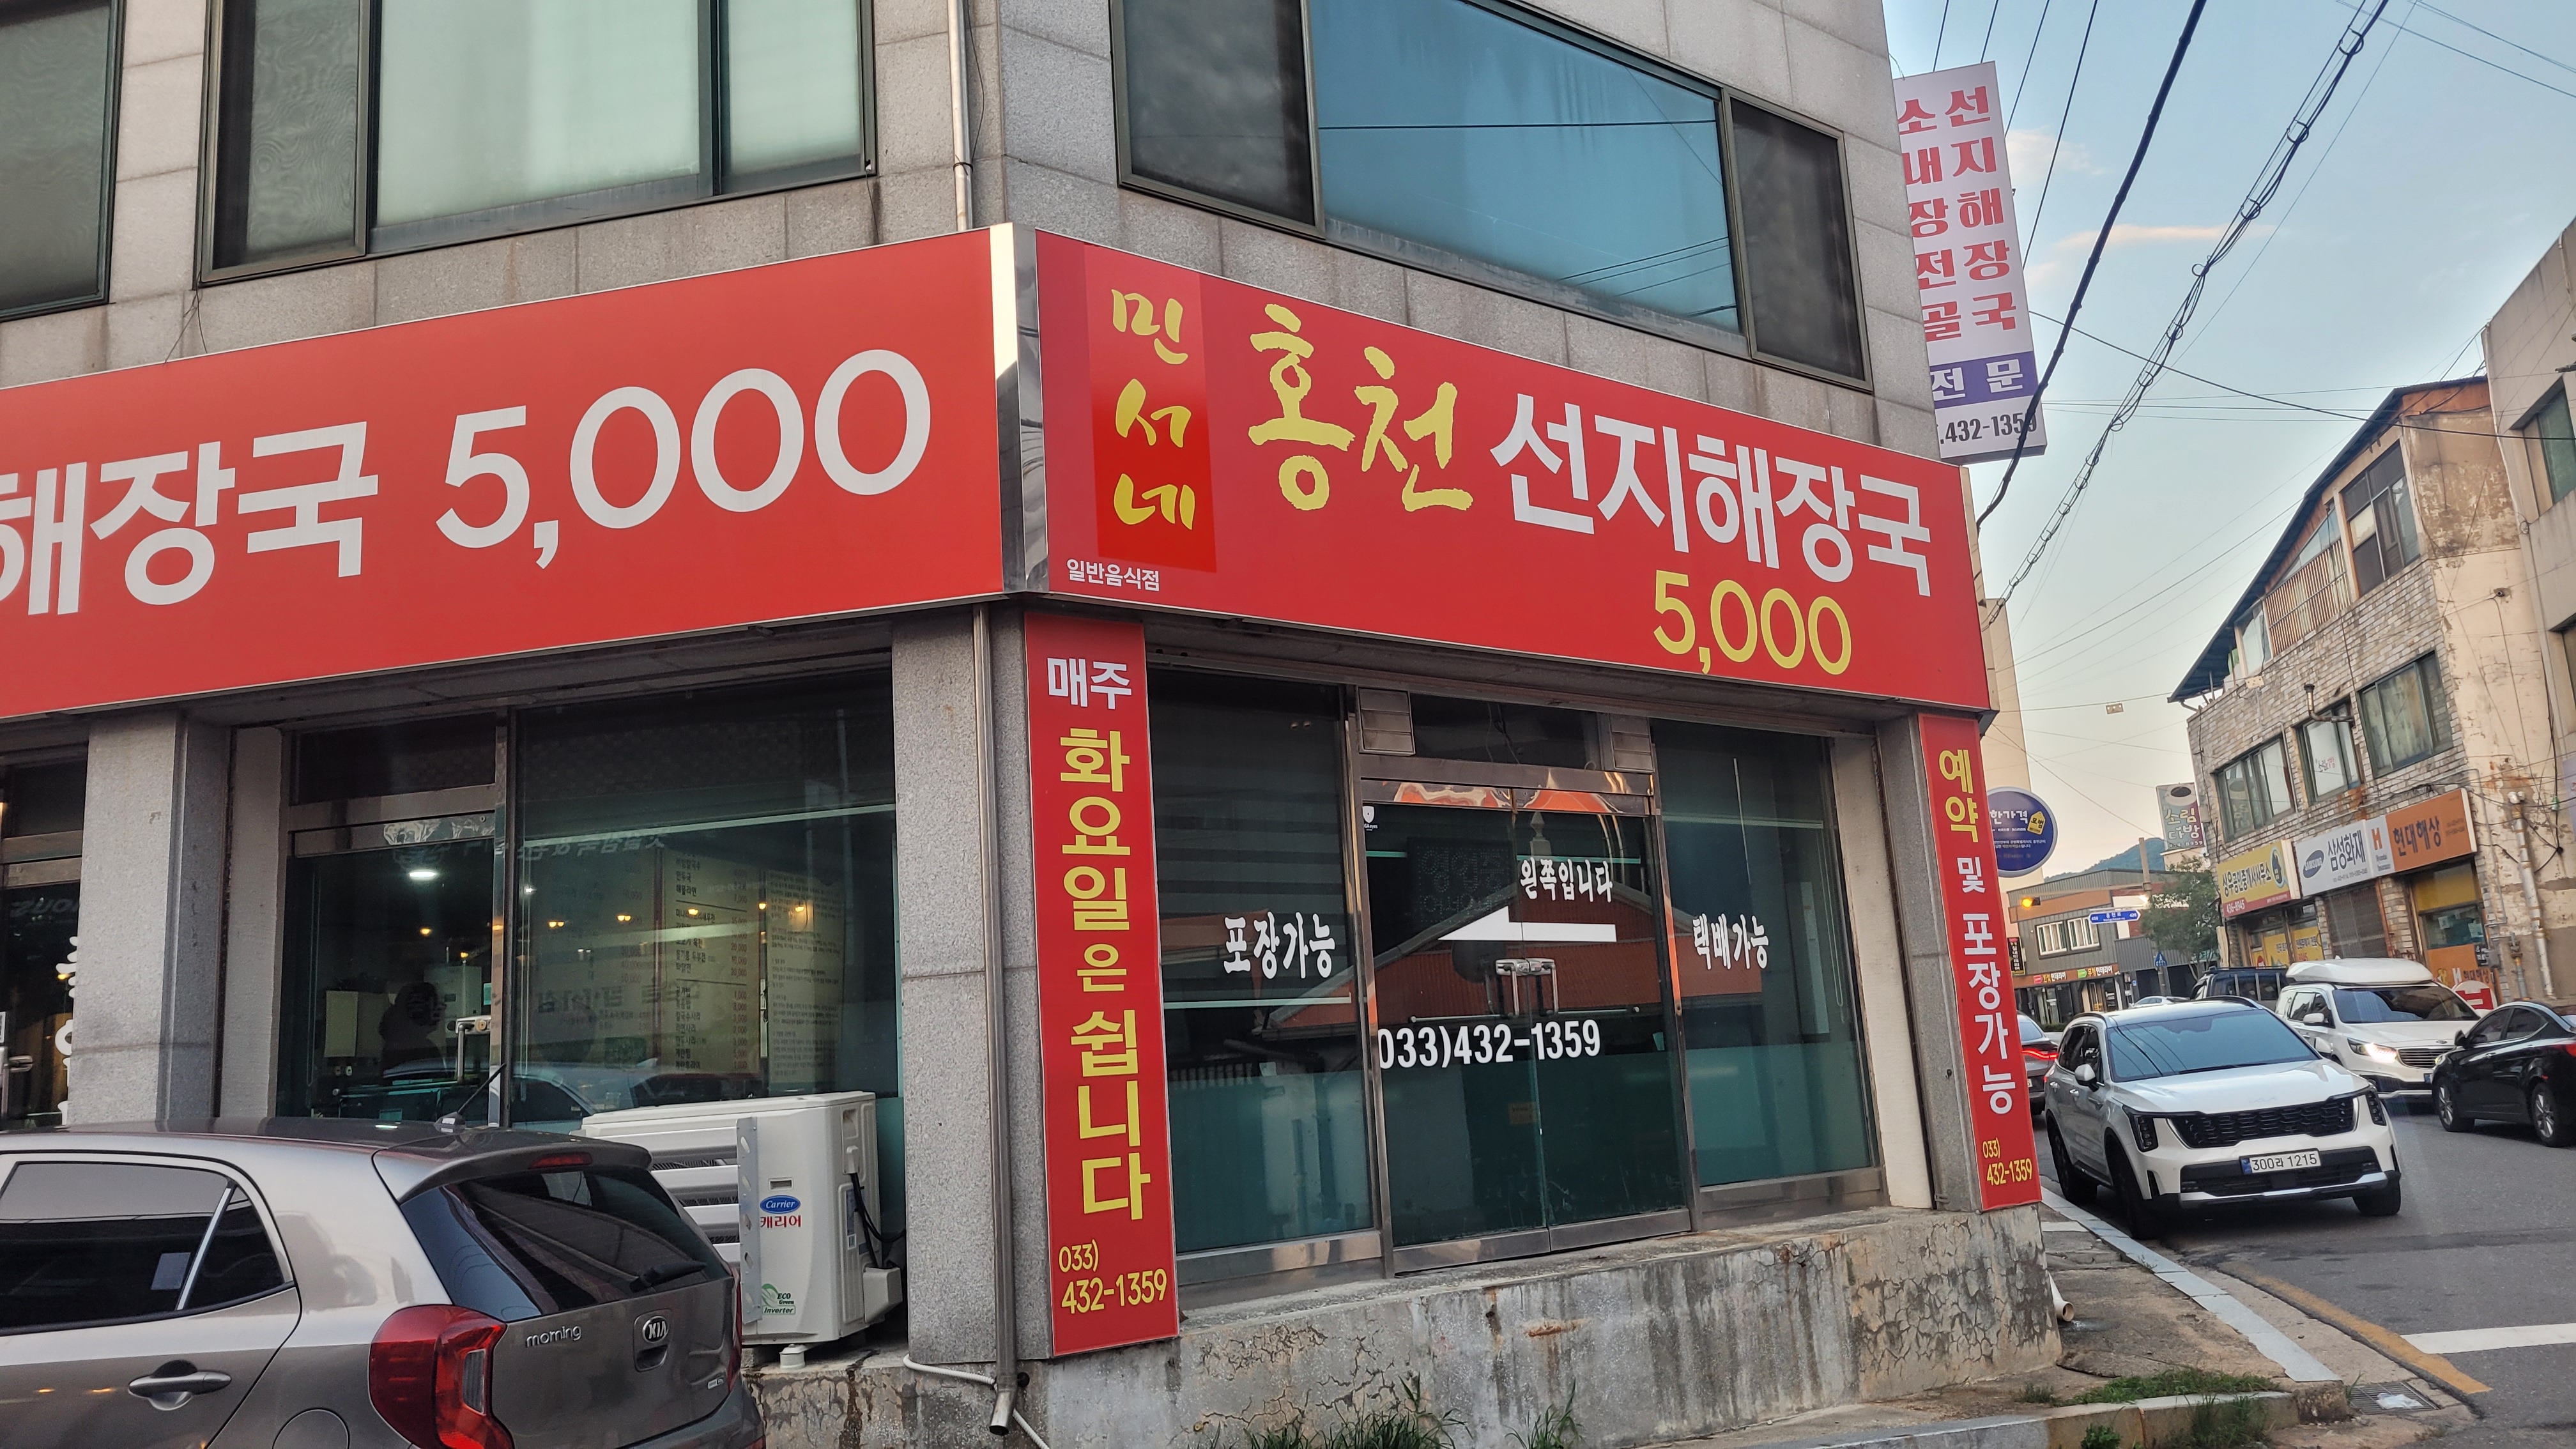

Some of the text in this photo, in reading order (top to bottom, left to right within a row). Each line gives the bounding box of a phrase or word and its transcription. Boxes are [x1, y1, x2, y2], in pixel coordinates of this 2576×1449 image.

[1945, 86, 2017, 330] 선지해장국
[1111, 289, 1195, 530] 민서네
[1248, 303, 1931, 597] 홍천 선지해장국
[0, 349, 931, 616] 해장국 5,000
[1066, 558, 1161, 592] 일반음식점
[1653, 569, 1852, 676] 5,000
[1047, 657, 1131, 710] 매주
[2030, 817, 2044, 829] 모범
[2165, 808, 2197, 825] 소림
[2168, 824, 2200, 839] 다방
[2393, 816, 2441, 857] 현대해상
[2304, 857, 2323, 871] SAMSUNG
[2327, 830, 2366, 872] 삼성화재
[1520, 857, 1613, 903] 왼쪽입니다
[1223, 912, 1335, 979] 포장가능
[1692, 914, 1769, 970] 택배가능
[1939, 749, 2016, 1114] 예약 및 포장가능
[1071, 1009, 1151, 1220] 쉽니다
[1982, 1137, 2001, 1159] 033)
[2251, 1153, 2317, 1171] 300라 1215
[1987, 1158, 2033, 1186] 432-1359
[760, 1215, 801, 1229] 캐리어
[765, 1200, 795, 1209] Carrier
[1059, 1239, 1099, 1273] 033)
[1061, 1268, 1167, 1314] 432-1359
[526, 1326, 582, 1347] morning
[648, 1321, 668, 1339] KIA
